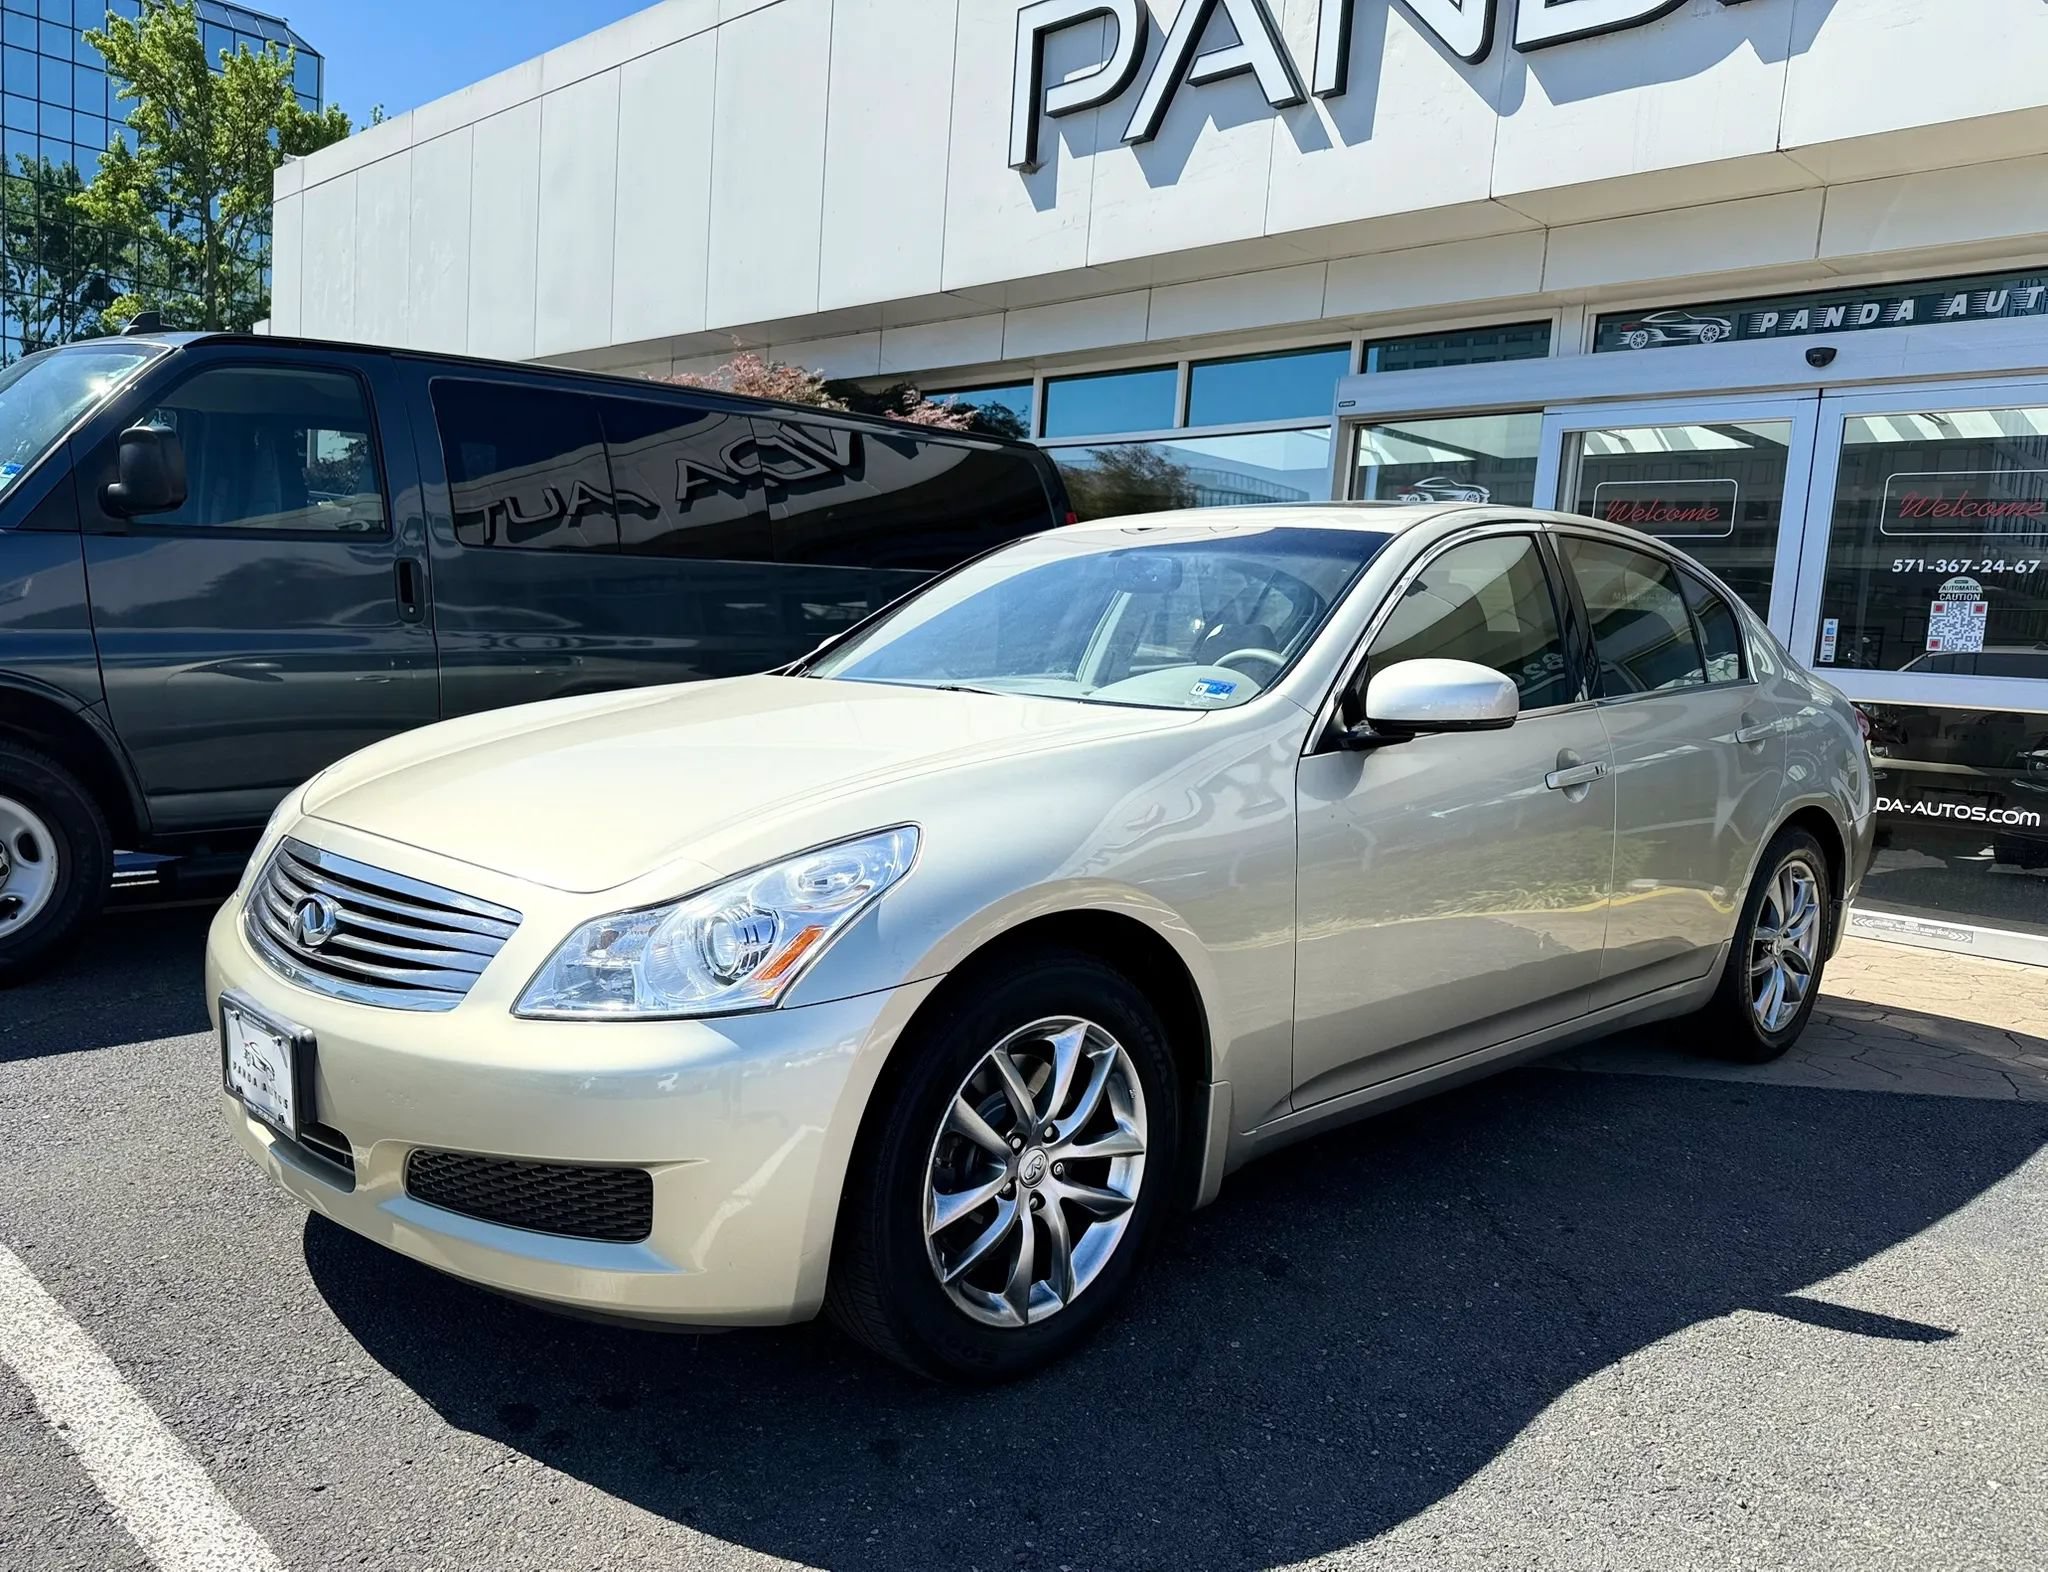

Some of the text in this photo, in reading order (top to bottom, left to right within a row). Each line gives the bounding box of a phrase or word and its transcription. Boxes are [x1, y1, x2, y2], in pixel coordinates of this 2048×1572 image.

[1008, 0, 1752, 172] PAN
[1749, 286, 2045, 334] PANDA AUT
[1606, 498, 1720, 522] Welcome
[1900, 489, 2048, 519] Welcome
[1892, 559, 2041, 575] 571-367-24-67
[1939, 593, 1981, 601] CAUTION
[1873, 797, 2040, 827] DA-AUTOS.COM
